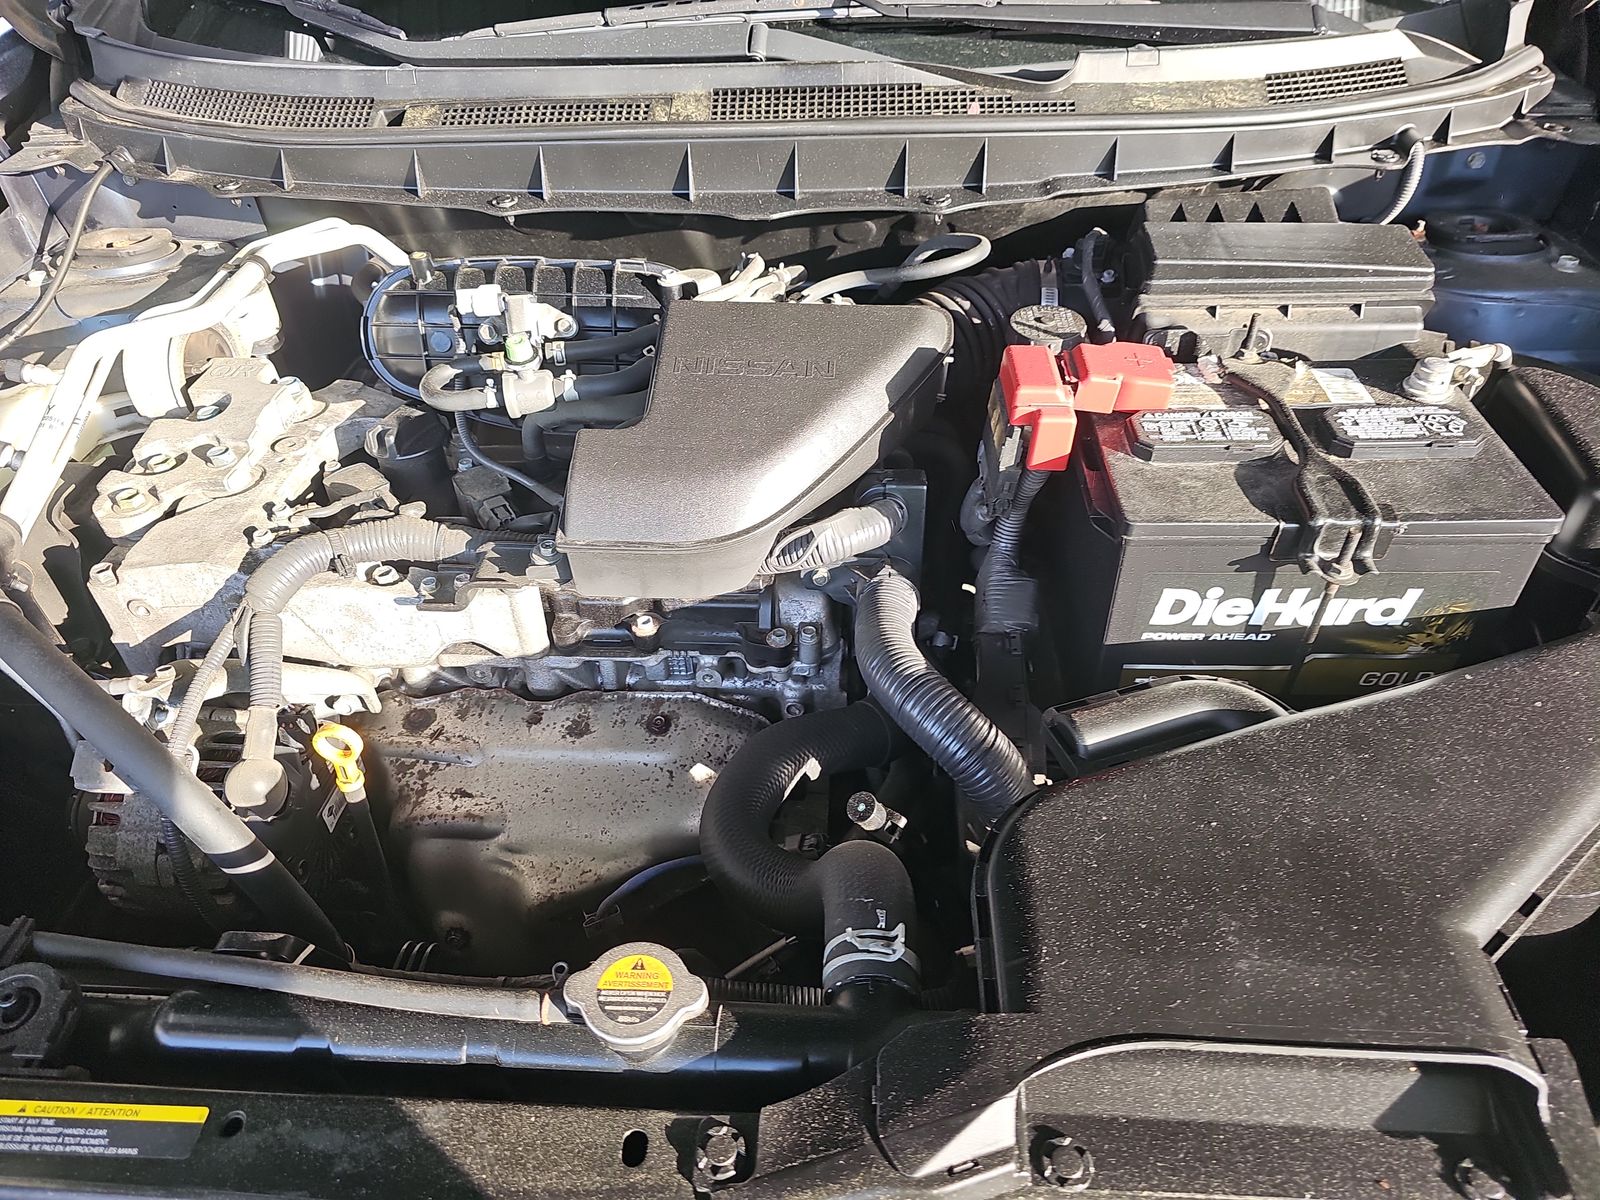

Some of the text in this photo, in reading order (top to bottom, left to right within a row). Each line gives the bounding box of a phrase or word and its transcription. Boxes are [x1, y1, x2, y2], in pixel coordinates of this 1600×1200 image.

[672, 356, 837, 378] NISSAN
[1149, 587, 1425, 627] DieHard
[1141, 632, 1275, 641] POWER AHEAD
[615, 971, 660, 980] WARNING
[602, 980, 670, 989] AVERTISSEMENT
[33, 1105, 78, 1114] CAUTION
[87, 1107, 141, 1117] ATTENTION
